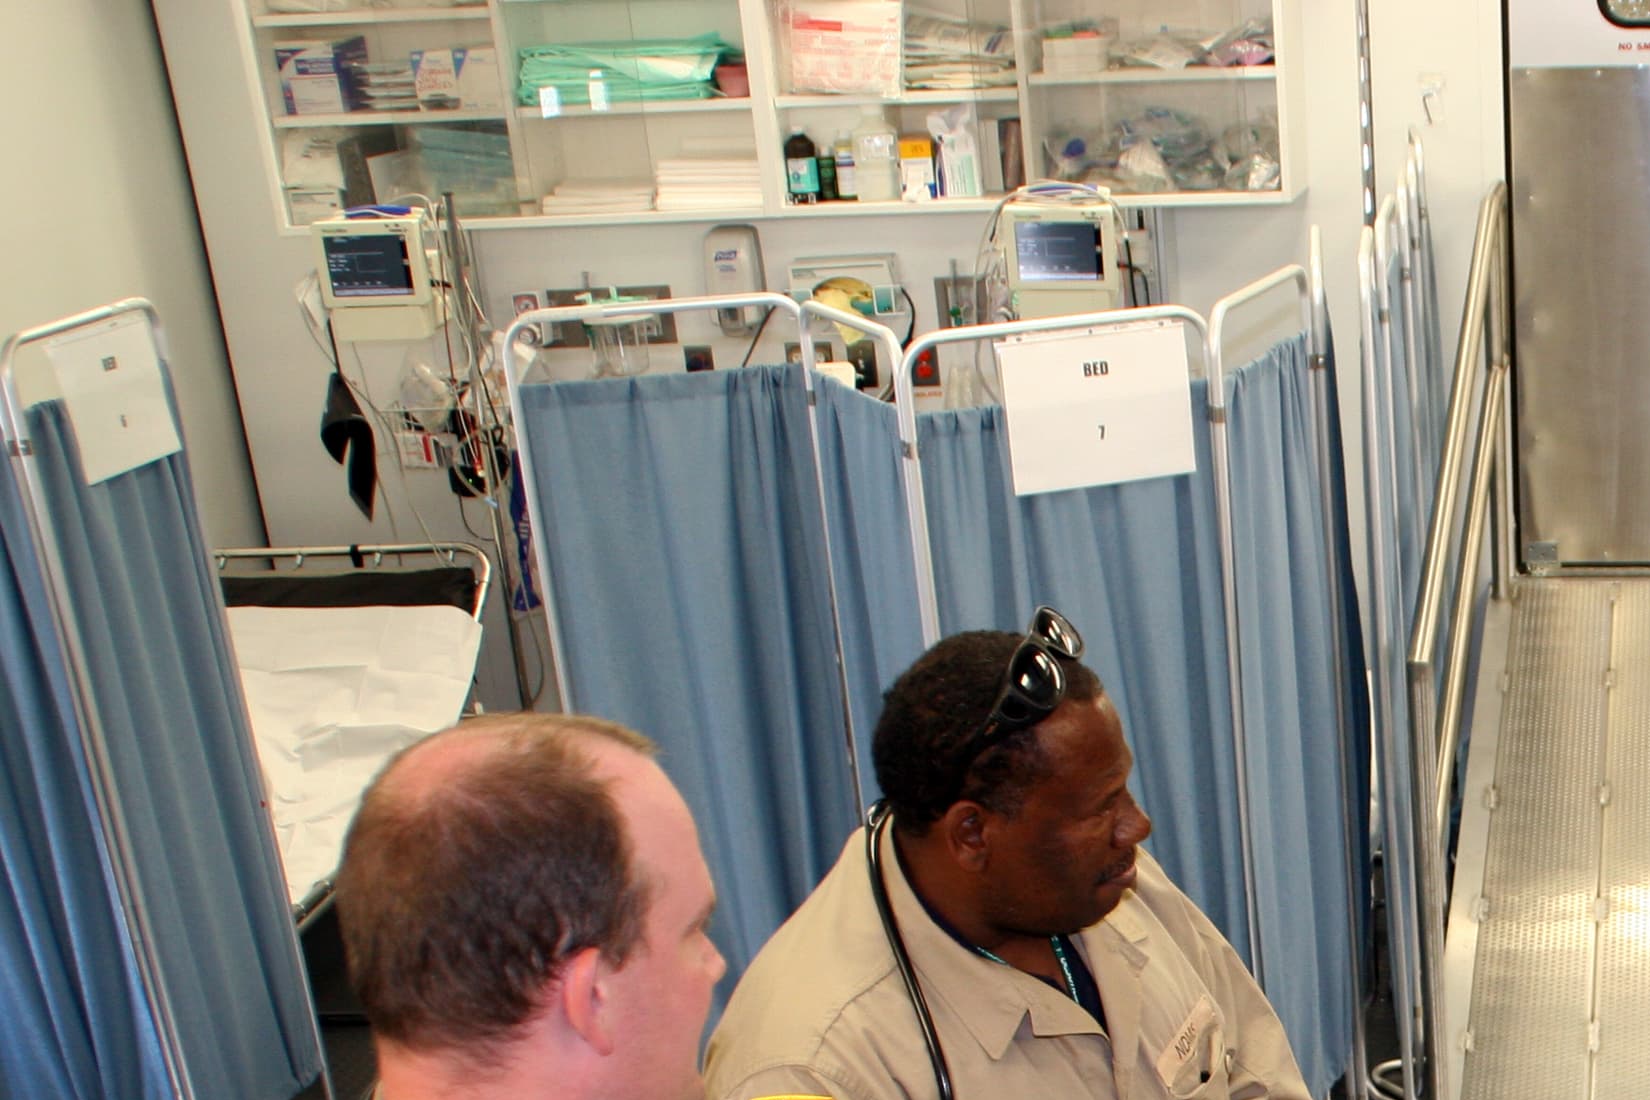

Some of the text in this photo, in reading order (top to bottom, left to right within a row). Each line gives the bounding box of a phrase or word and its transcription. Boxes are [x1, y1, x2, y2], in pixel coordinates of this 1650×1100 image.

[1618, 42, 1632, 50] NO
[1083, 361, 1109, 377] BED
[1098, 425, 1105, 440] 7
